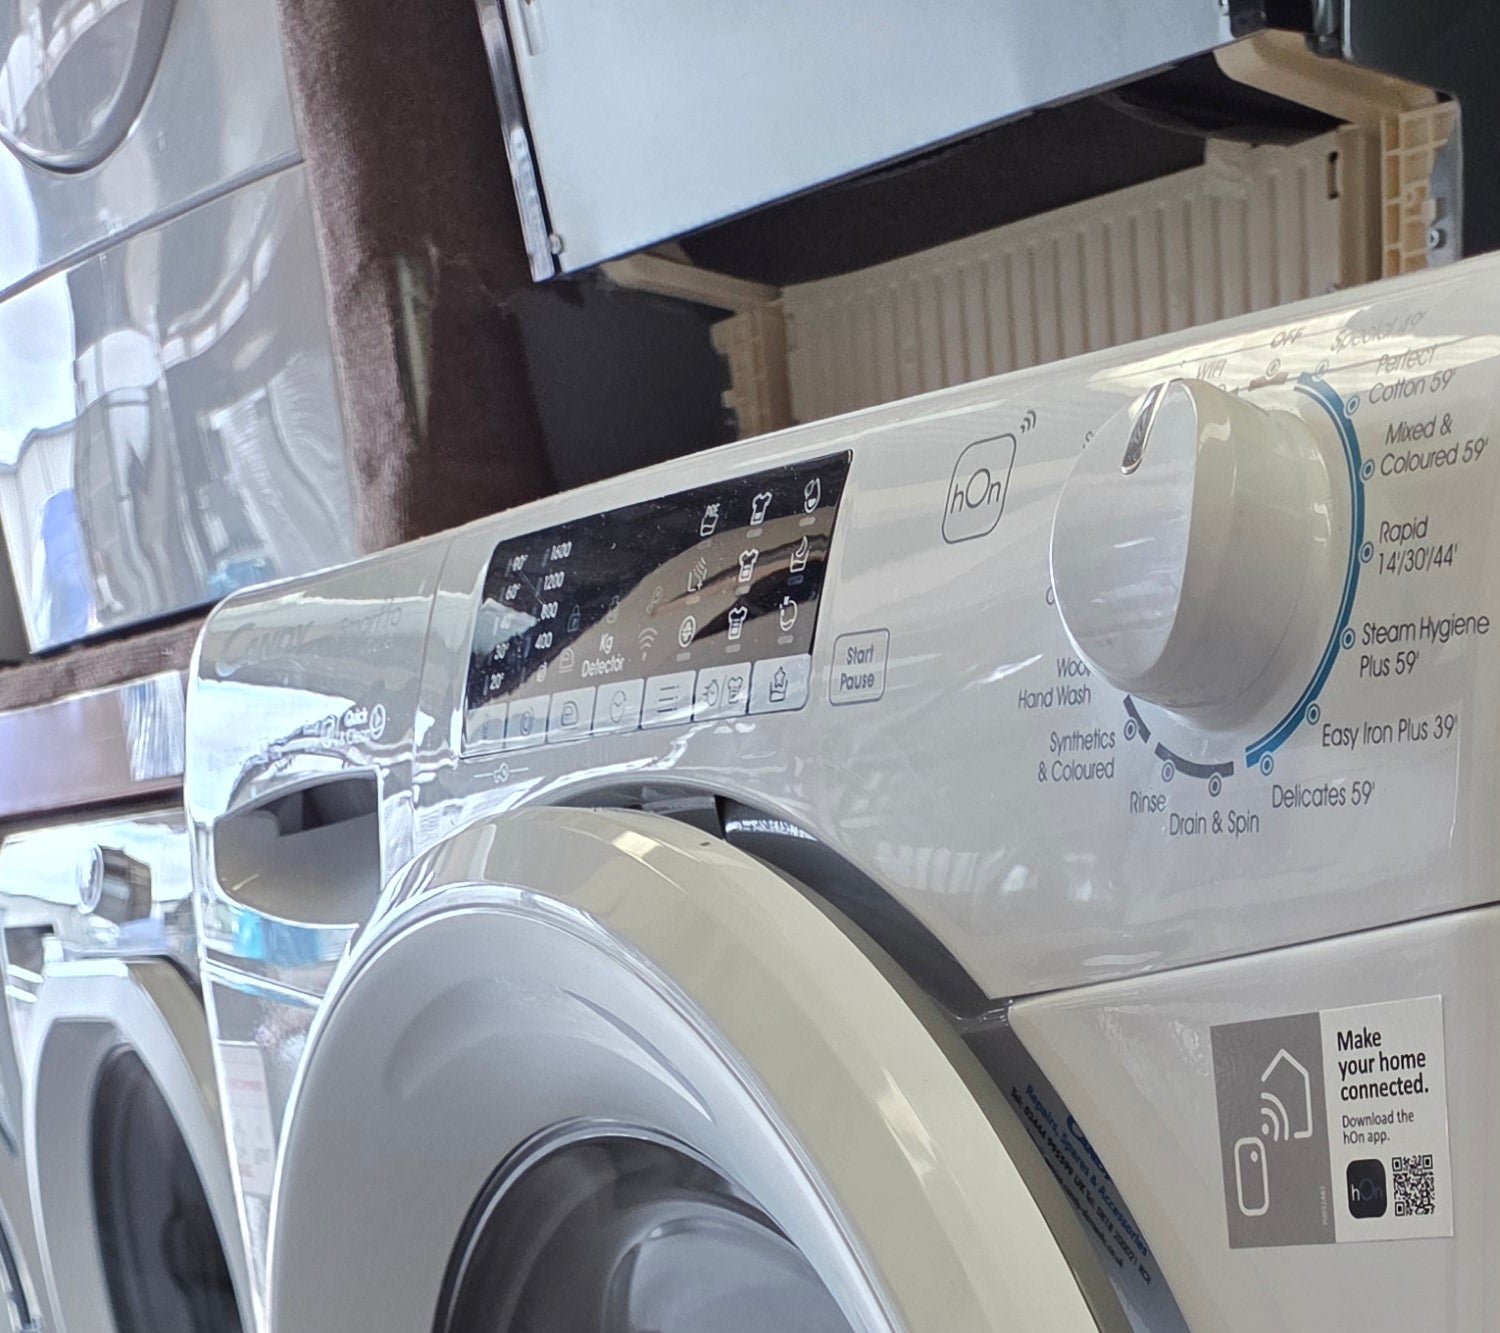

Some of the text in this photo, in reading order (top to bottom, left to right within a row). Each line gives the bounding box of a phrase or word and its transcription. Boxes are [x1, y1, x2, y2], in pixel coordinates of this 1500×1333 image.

[1270, 328, 1305, 349] OFF
[1375, 345, 1438, 376] Perfect
[1368, 367, 1457, 405] Cotton 59'
[1384, 412, 1454, 446] Mixed &
[1379, 437, 1489, 477] Coloured 59'
[950, 467, 1001, 514] hOn
[1378, 516, 1429, 546] Rapid
[543, 571, 565, 591] 1200
[534, 632, 553, 650] 400
[1361, 615, 1490, 646] Steam Hygiene
[600, 633, 614, 655] Kg
[846, 643, 874, 666] Start
[581, 653, 626, 678] Detector
[1359, 650, 1420, 679] Plus 59'
[840, 672, 875, 692] Pause
[1017, 684, 1091, 709] Hand Wash
[1049, 730, 1116, 753] Synthetics
[1322, 714, 1458, 751] Easy Iron Plus 39'
[1037, 758, 1115, 783] & Coloured
[1129, 790, 1168, 814] Rinse
[1272, 781, 1375, 808] Delicates 59'
[1169, 810, 1260, 837] Drain & Spin
[1337, 1027, 1382, 1052] Make
[1338, 1051, 1426, 1082] your home
[1340, 1072, 1429, 1101] connected.
[1342, 1109, 1414, 1129] Download the
[1343, 1130, 1390, 1145] hOn app.
[1098, 1185, 1148, 1257] Accessories
